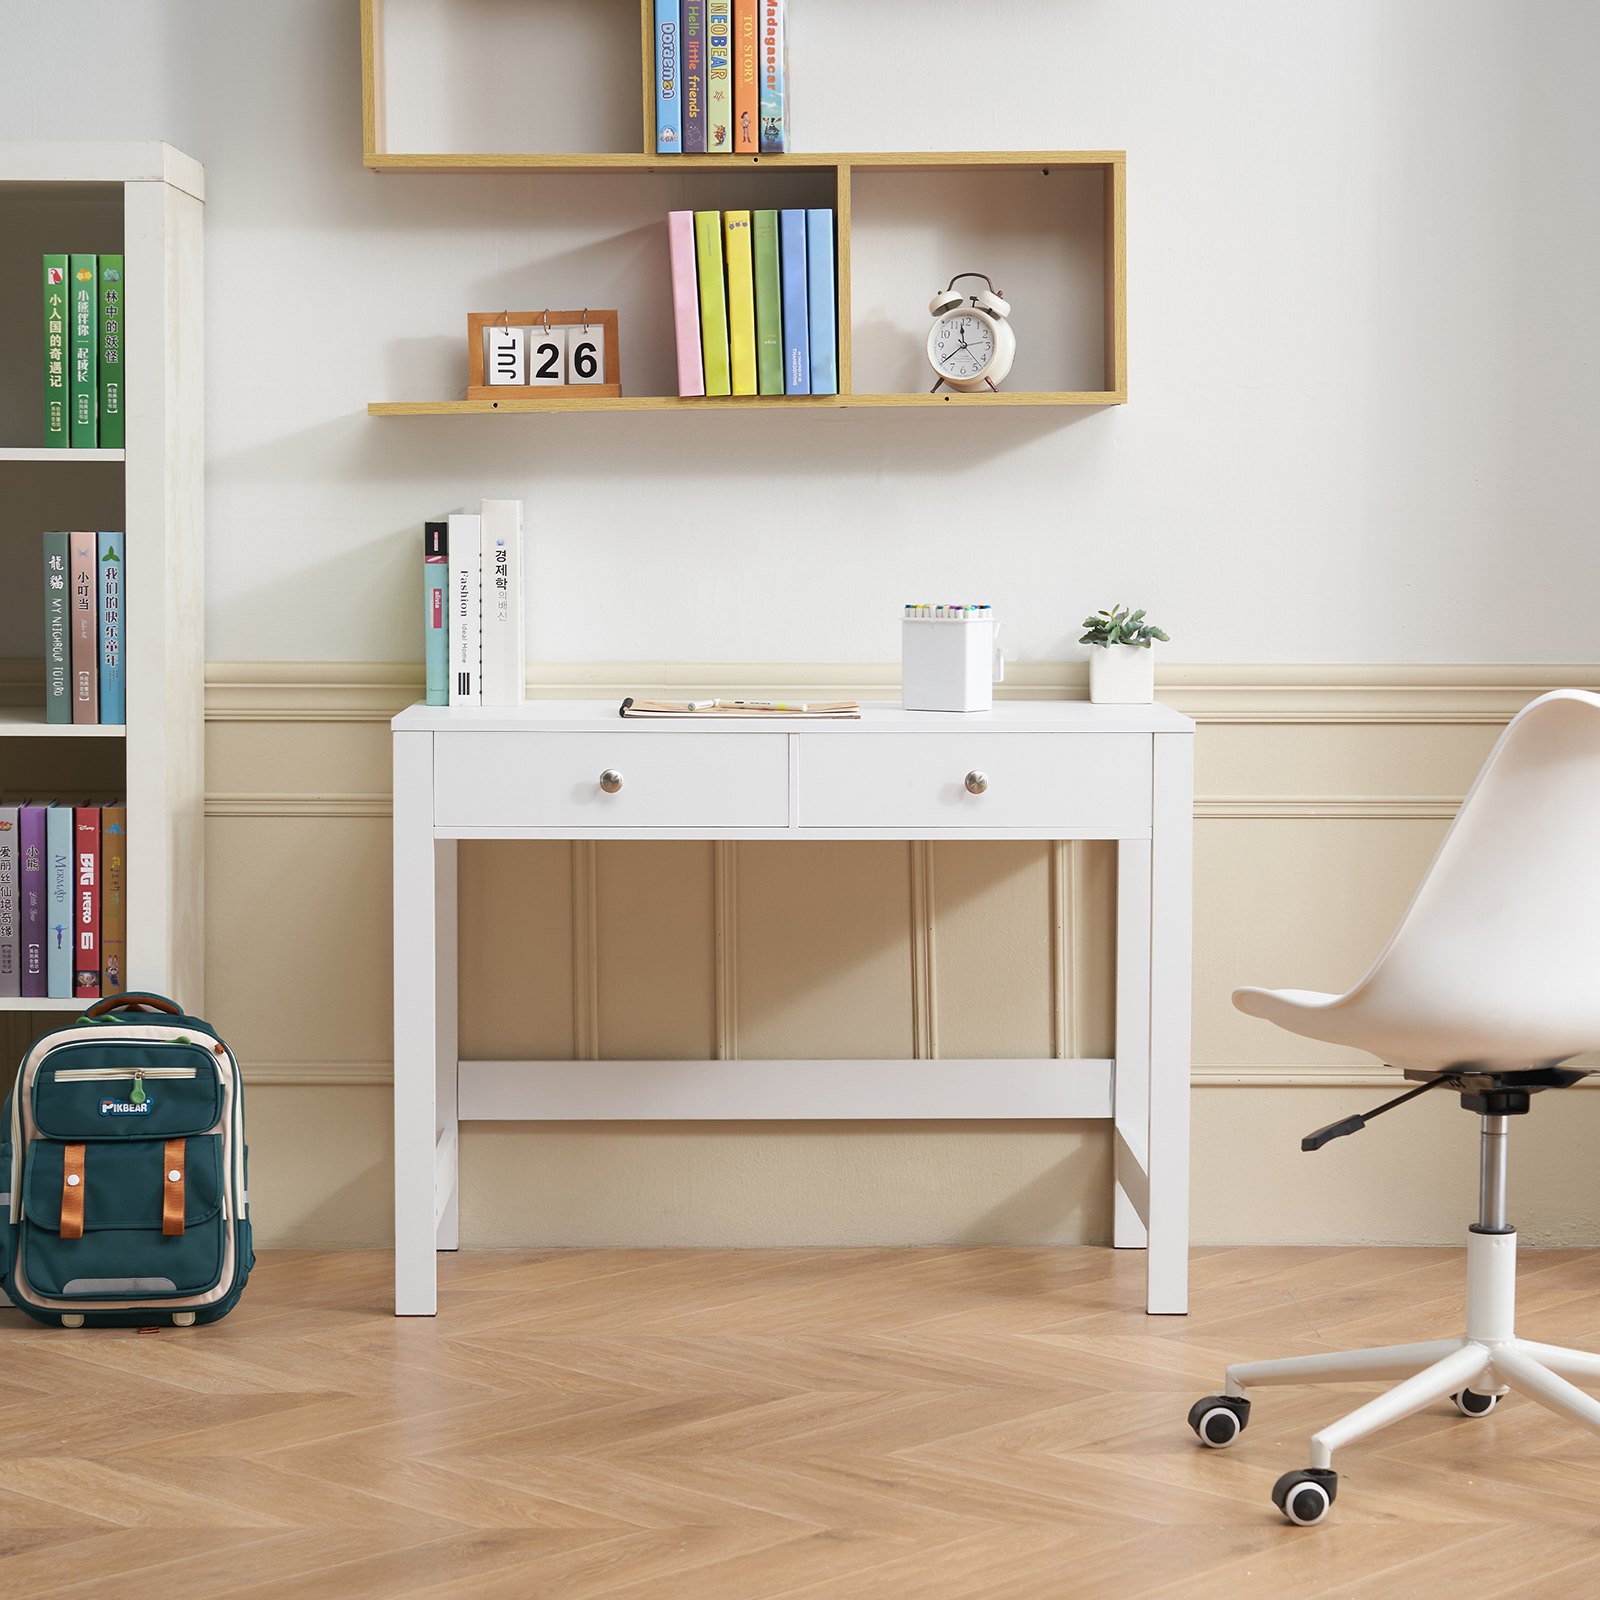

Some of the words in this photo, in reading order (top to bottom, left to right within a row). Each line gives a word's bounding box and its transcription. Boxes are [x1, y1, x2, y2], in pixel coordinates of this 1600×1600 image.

[688, 6, 699, 36] Hello
[743, 15, 753, 39] TOY
[688, 41, 700, 70] little
[711, 3, 727, 80] NEOBEAR
[660, 22, 676, 100] Doraemon
[743, 45, 753, 85] STORY
[687, 75, 701, 118] friends
[49, 294, 62, 388] 小人国的奇遇记
[105, 290, 119, 363] 林中的妖怪
[940, 330, 951, 339] 10
[982, 330, 988, 339] 2
[498, 339, 516, 379] JUL
[985, 341, 991, 351] 3
[950, 362, 956, 371] 7
[960, 366, 966, 375] 6
[972, 363, 979, 372] 5
[49, 555, 64, 590] 龍貓
[51, 598, 62, 614] MY
[78, 571, 89, 611] 小叮当
[460, 570, 468, 617] Fashion
[105, 567, 119, 667] 我们的快乐童年
[51, 616, 64, 663] NEIGHBOUR
[52, 667, 64, 697] TOTORO
[55, 855, 66, 902] MERMAID
[80, 853, 94, 886] BIG
[0, 846, 12, 937] 爱丽丝仙境奇缘
[82, 892, 92, 924] HERO
[81, 932, 93, 950] 6
[102, 1100, 148, 1113] PIKBEAR
